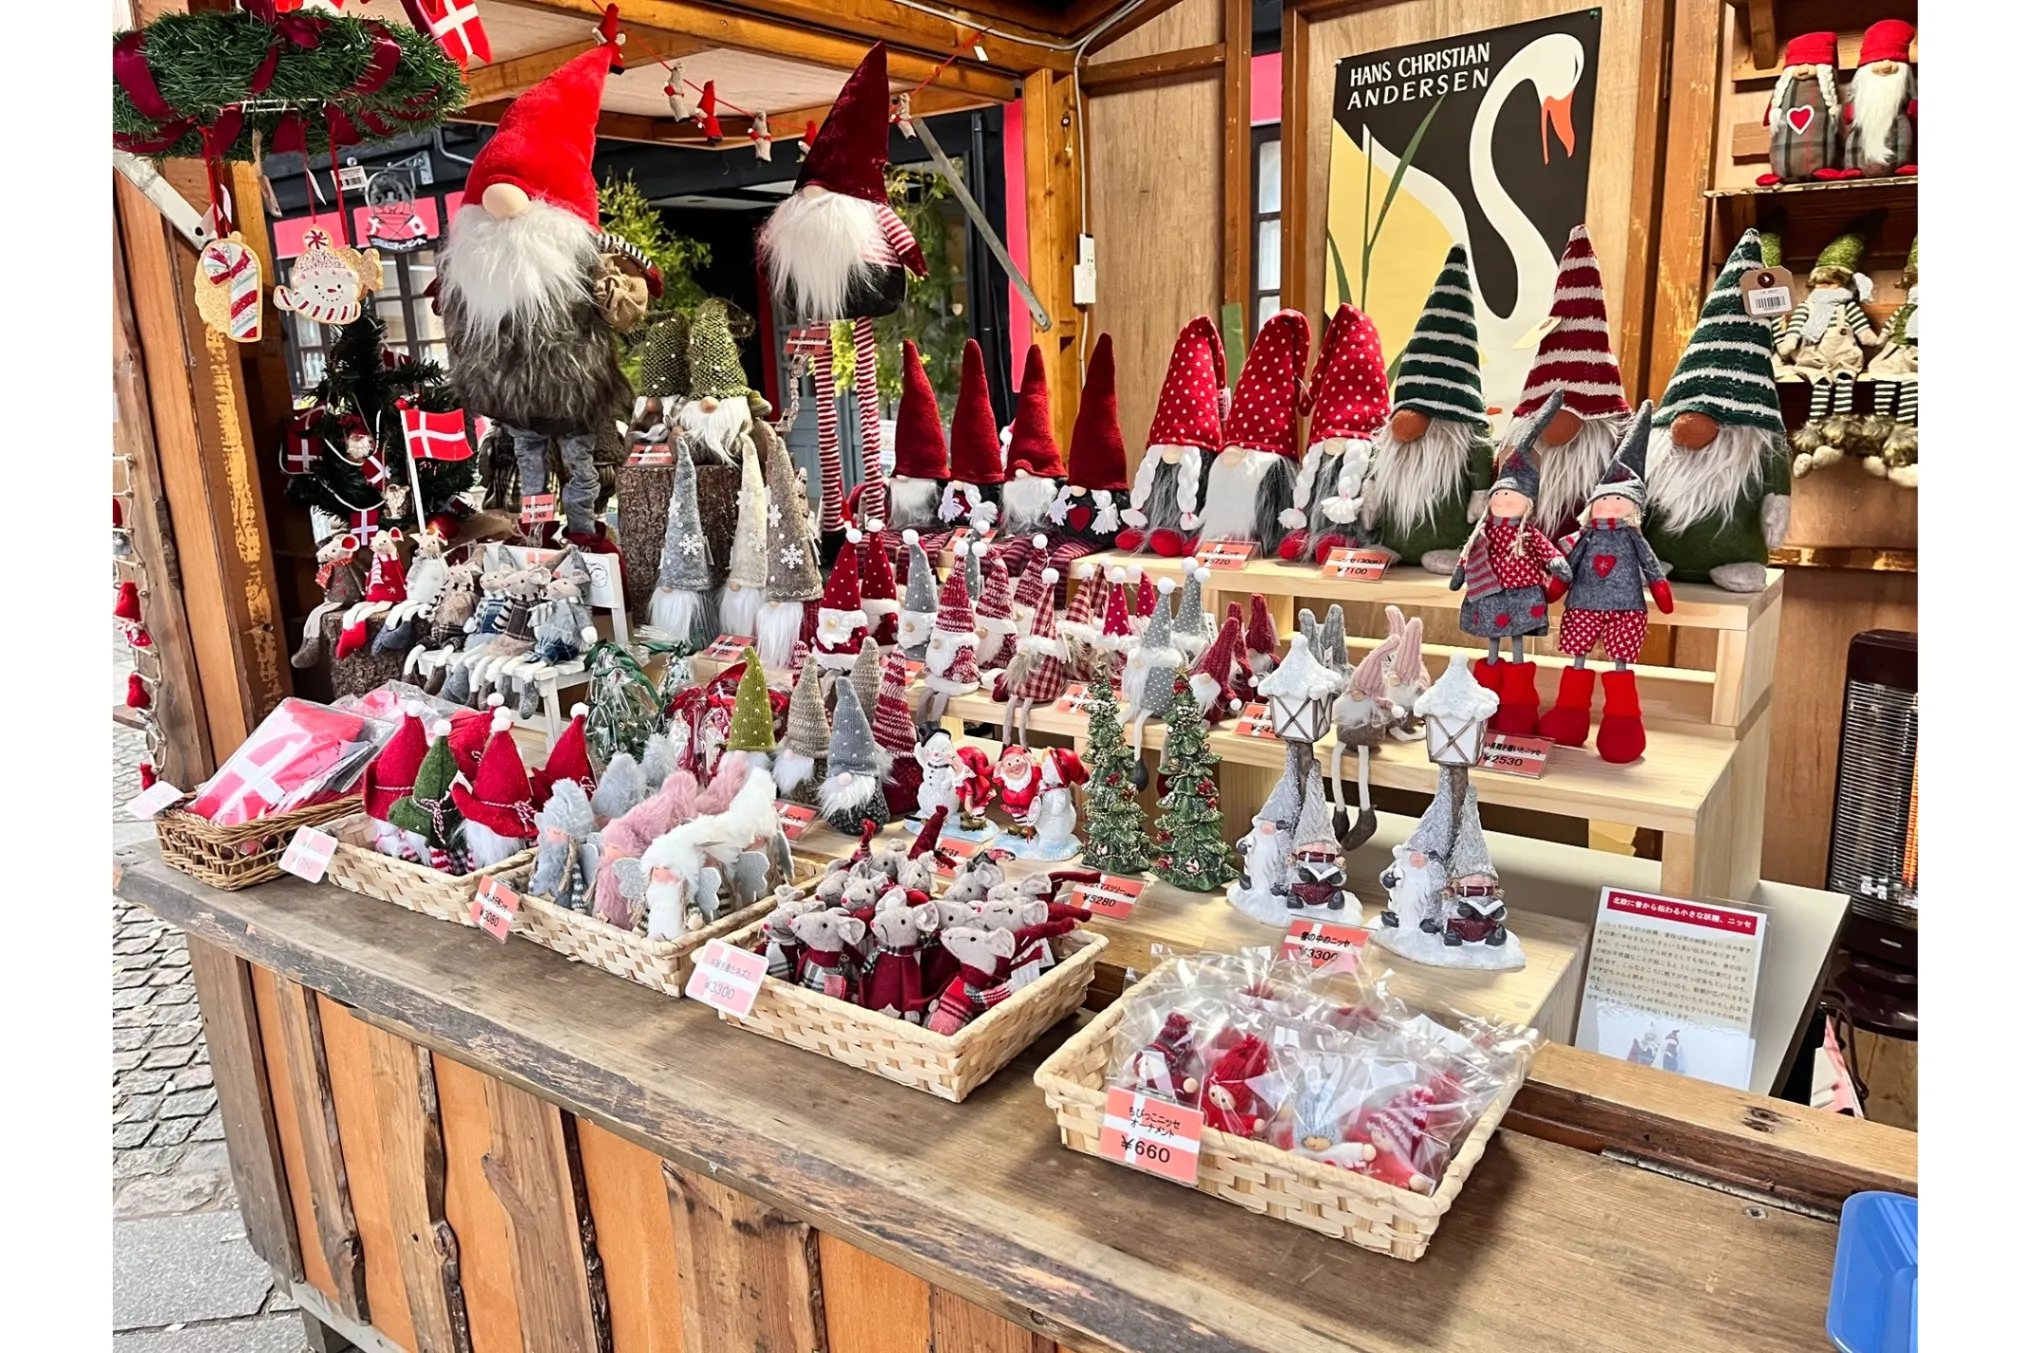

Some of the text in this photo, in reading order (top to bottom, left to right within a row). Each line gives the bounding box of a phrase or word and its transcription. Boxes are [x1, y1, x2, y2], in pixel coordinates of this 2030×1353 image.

[1350, 42, 1490, 87] HANS CHRISTIAN
[1347, 67, 1489, 110] ANDERSEN
[1482, 754, 1524, 767] ¥2530
[1083, 893, 1117, 908] ¥5280
[704, 976, 735, 1000] ¥3300
[1129, 1106, 1181, 1130] ちびっこニッセ
[1130, 1118, 1175, 1139] オーナメント
[1120, 1134, 1171, 1164] ¥660
